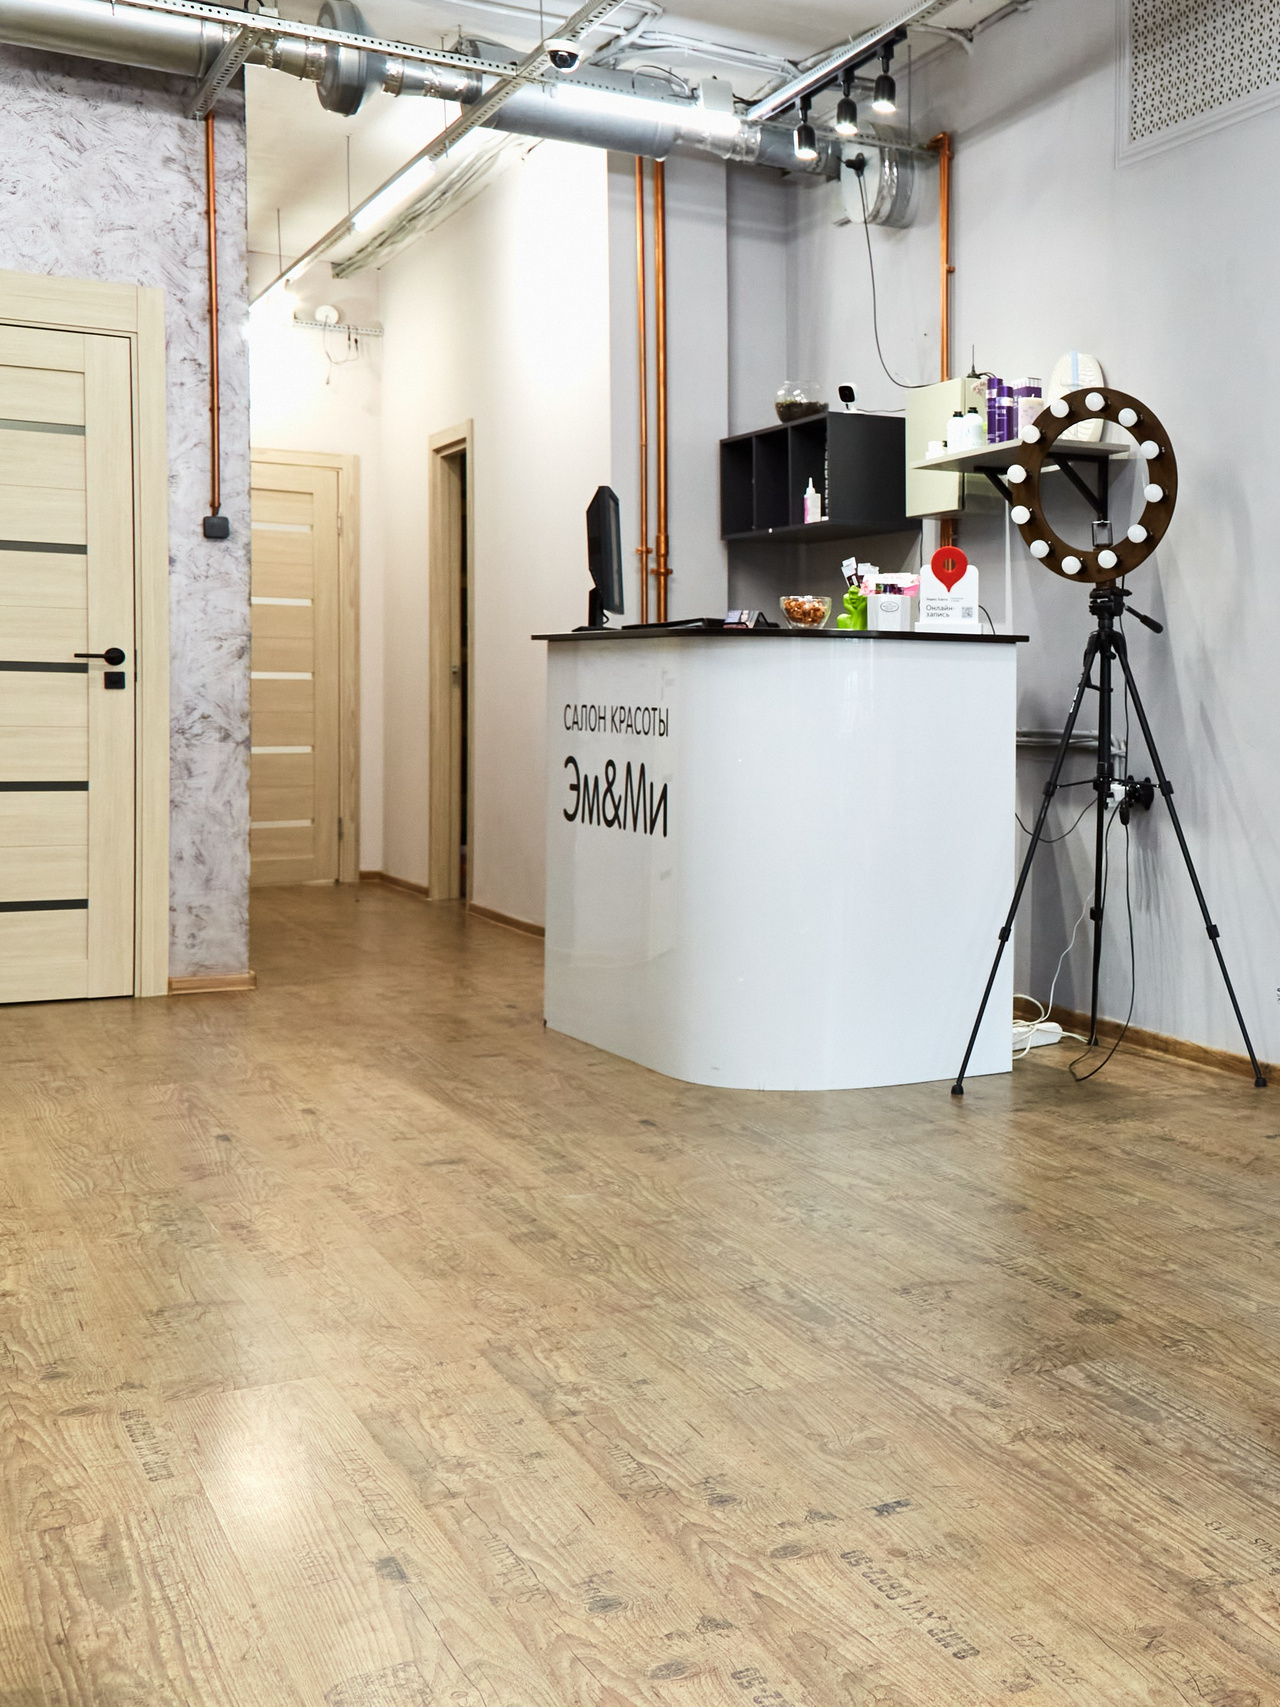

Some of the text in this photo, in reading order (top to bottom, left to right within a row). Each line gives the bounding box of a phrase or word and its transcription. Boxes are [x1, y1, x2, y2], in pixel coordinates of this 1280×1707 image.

[564, 704, 669, 737] САЛОН КРАСОТЫ
[563, 755, 667, 838] Эм&Ми
